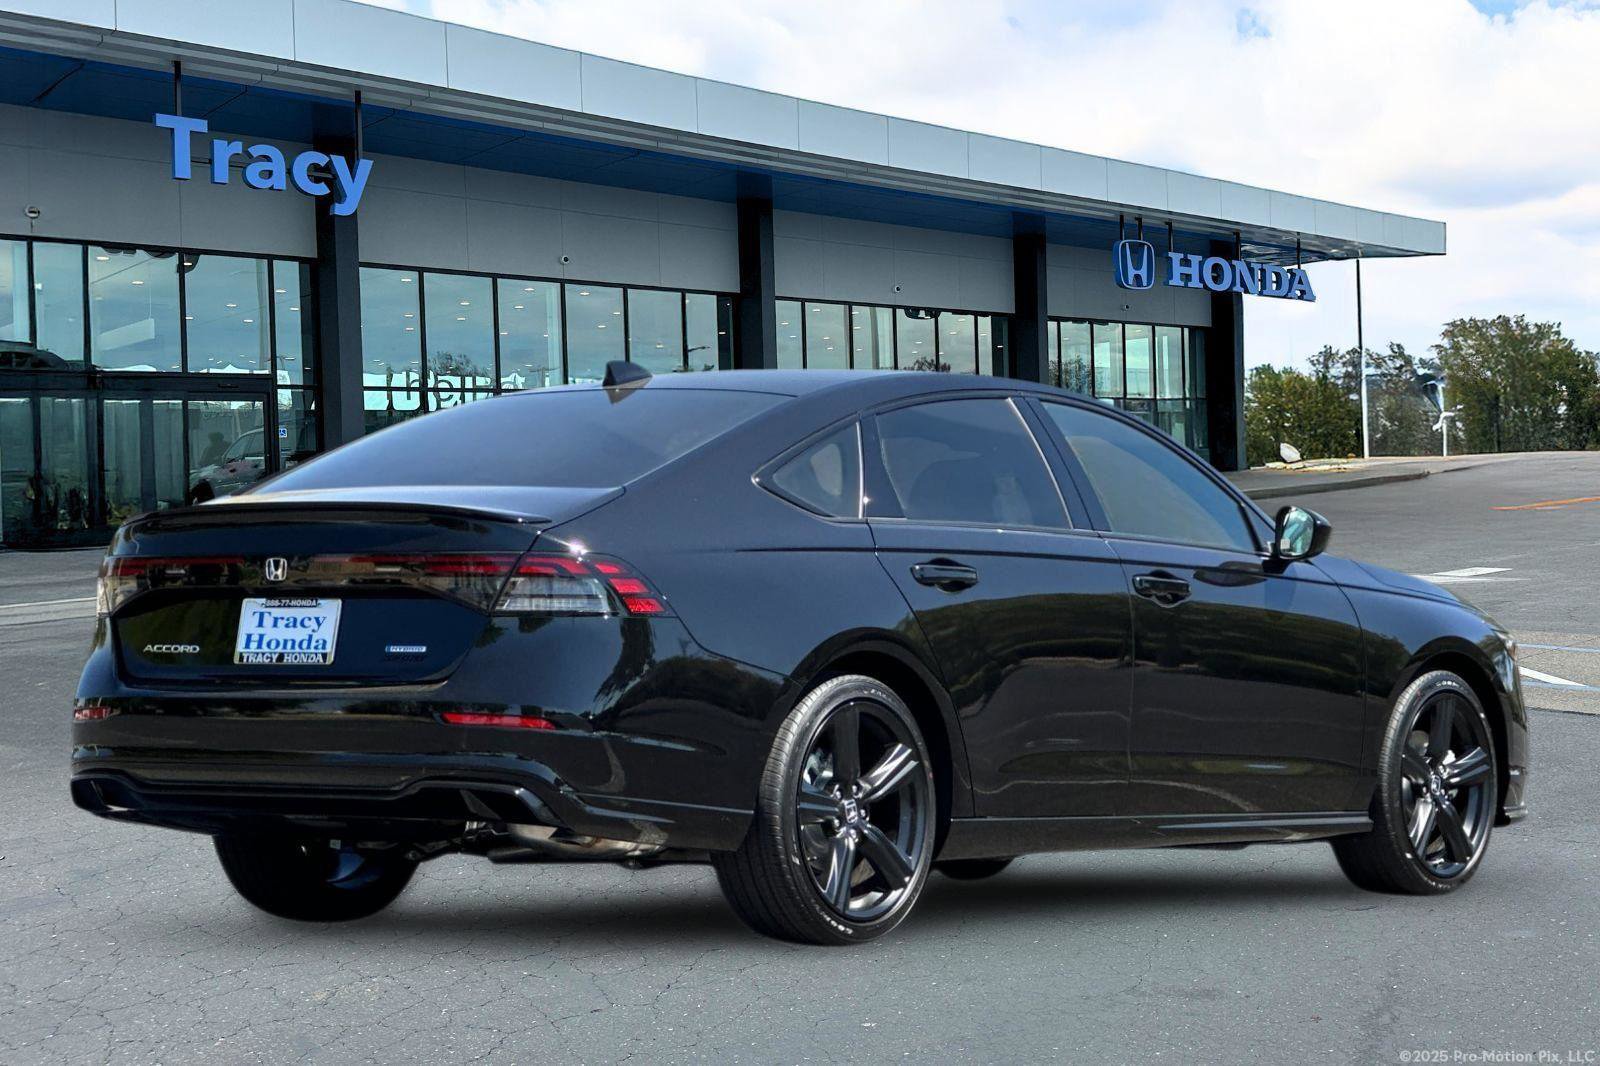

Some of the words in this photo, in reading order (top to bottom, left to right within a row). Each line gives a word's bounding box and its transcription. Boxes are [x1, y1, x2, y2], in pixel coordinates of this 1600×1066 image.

[155, 113, 374, 216] Tracy
[1167, 251, 1316, 301] HONDA
[252, 611, 327, 633] Tracy
[143, 645, 200, 653] ACCORD
[242, 633, 328, 650] Honda
[243, 652, 279, 663] TRACY
[283, 652, 324, 663] HONDA
